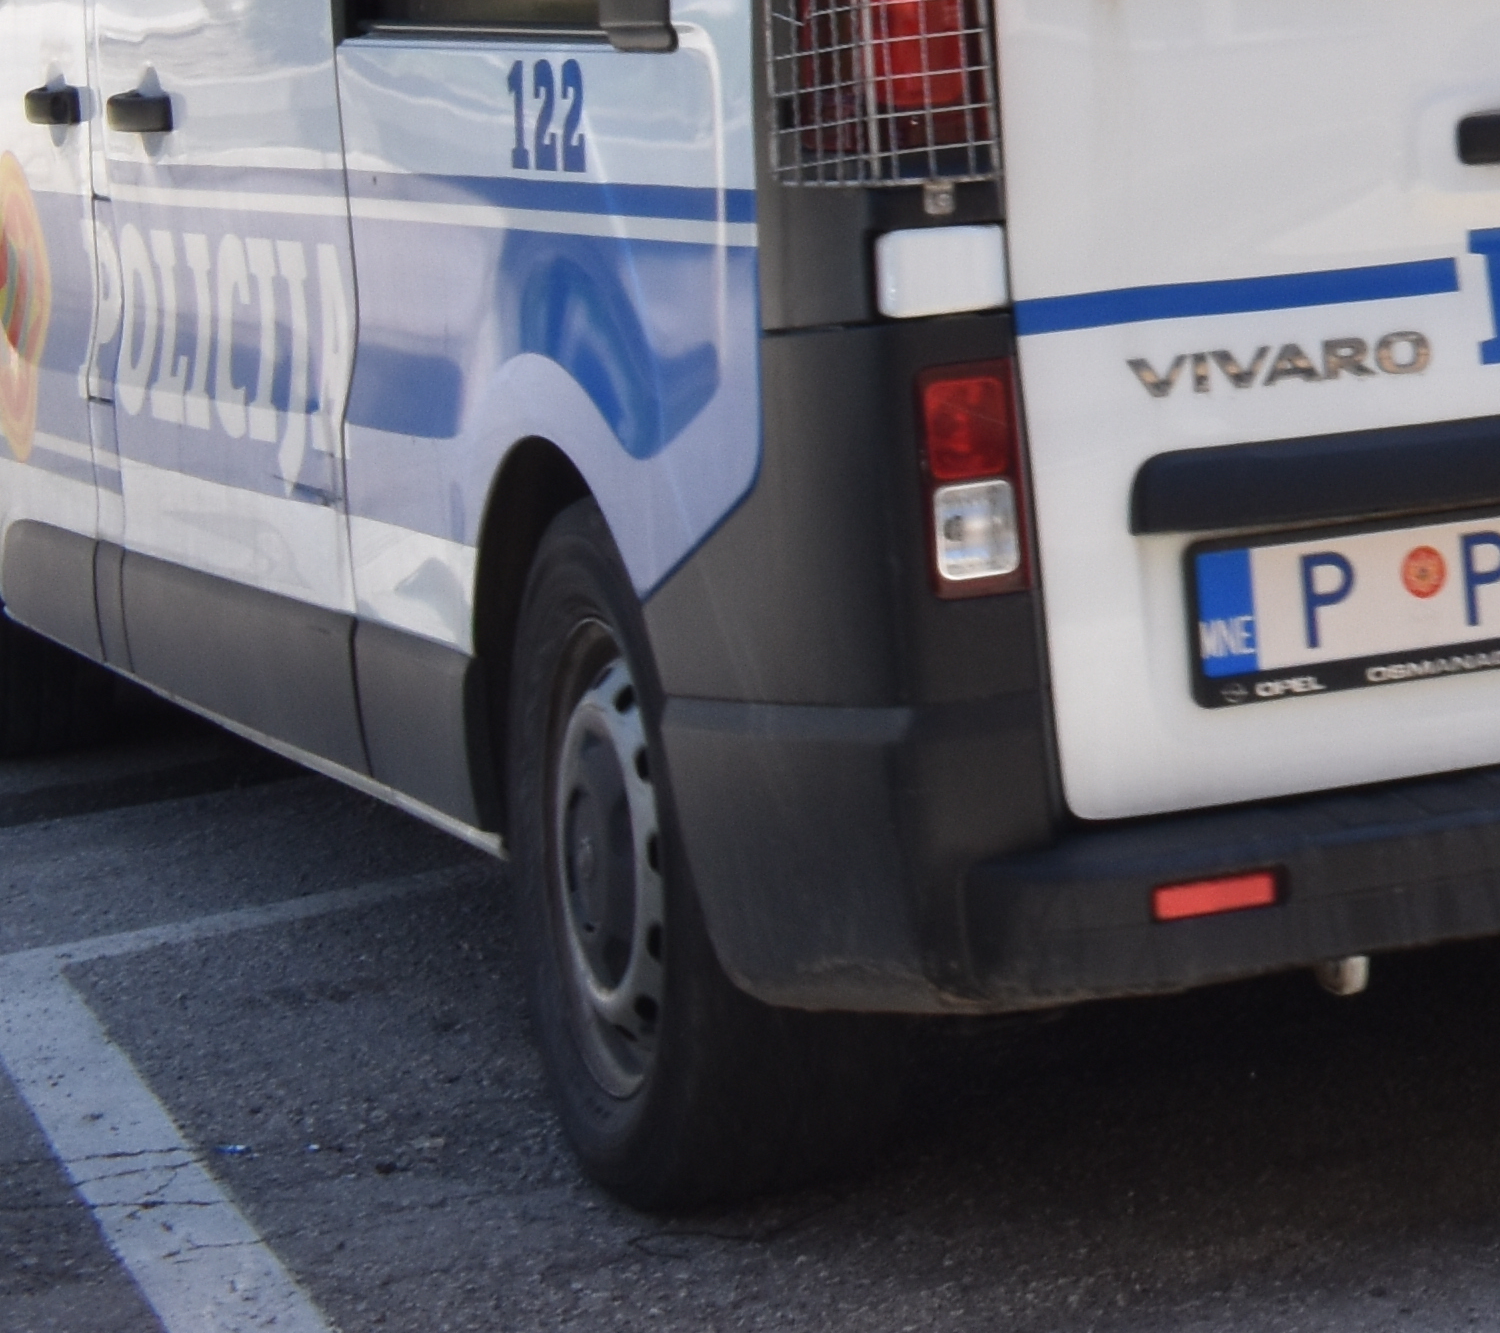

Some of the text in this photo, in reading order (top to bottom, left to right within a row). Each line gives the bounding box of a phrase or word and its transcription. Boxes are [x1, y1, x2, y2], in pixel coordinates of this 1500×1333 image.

[507, 58, 587, 173] 122
[78, 216, 353, 496] POLICIJA
[1126, 329, 1431, 399] VIVARO
[1300, 550, 1355, 650] P
[1254, 675, 1328, 698] OPEL
